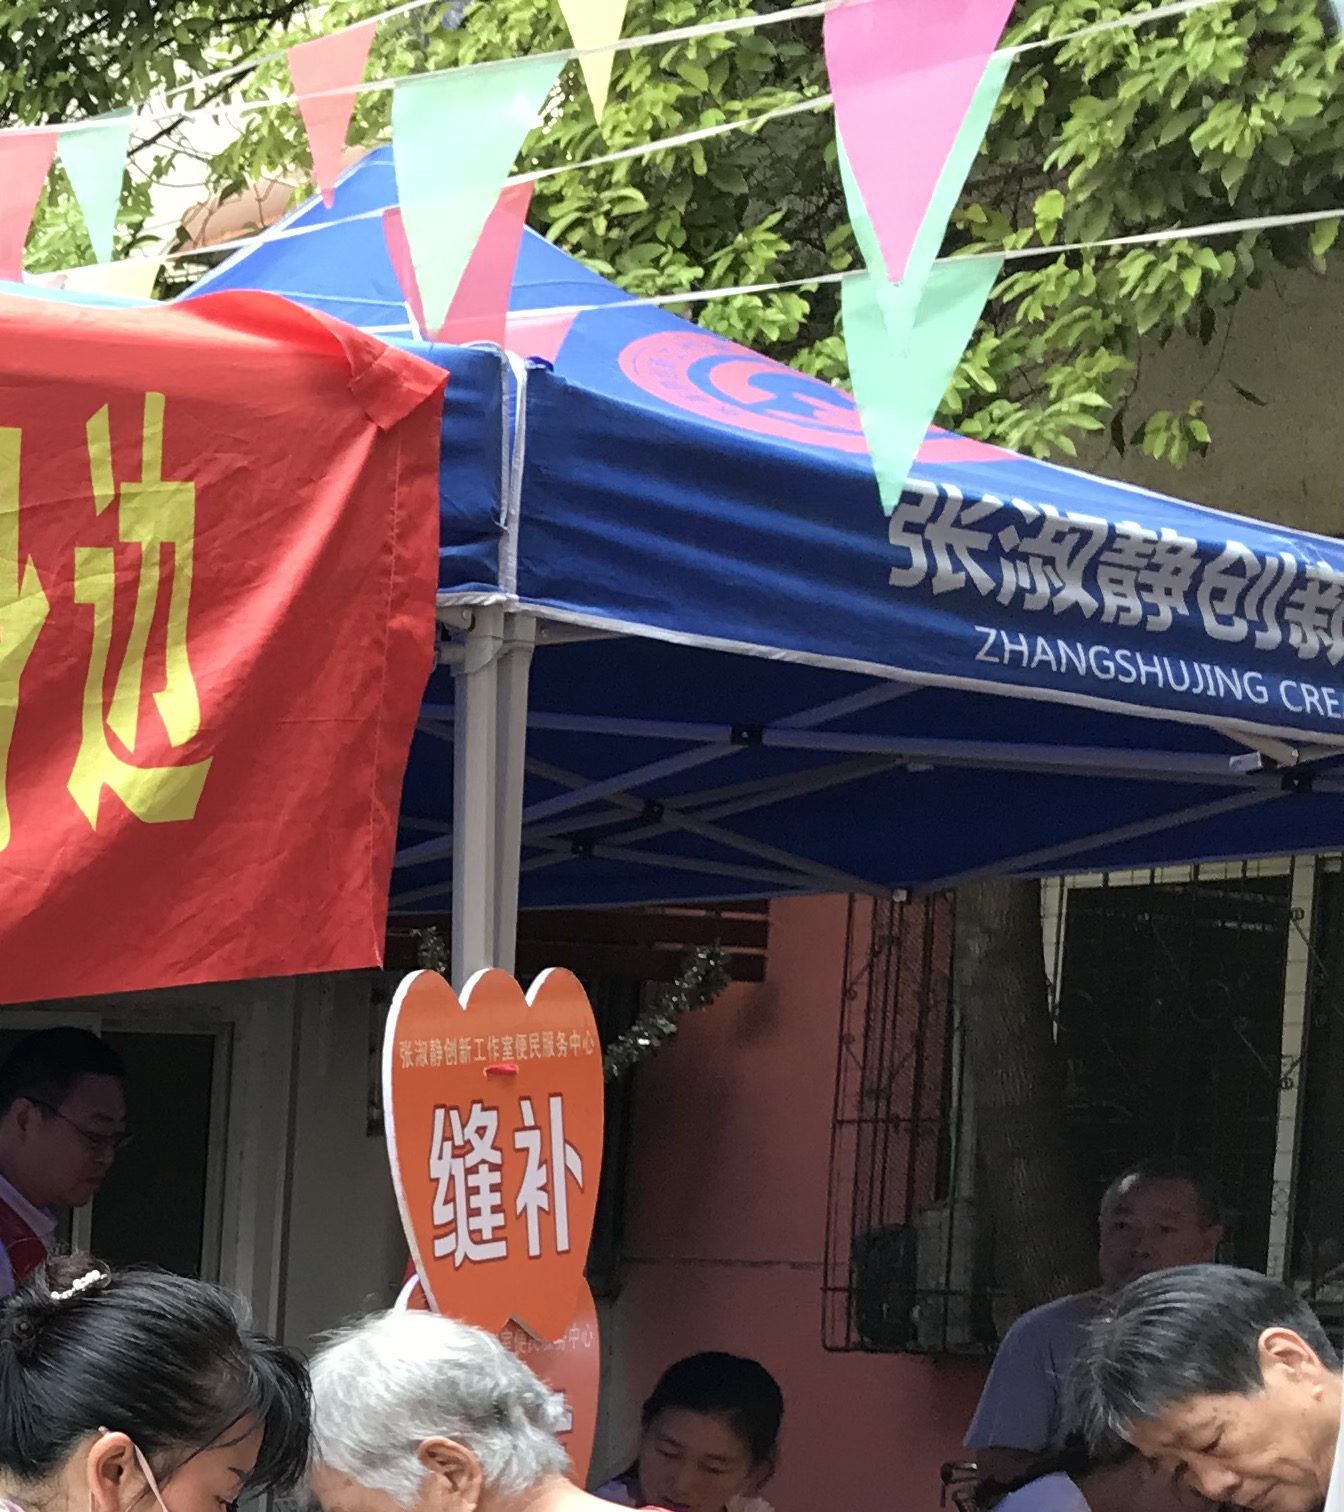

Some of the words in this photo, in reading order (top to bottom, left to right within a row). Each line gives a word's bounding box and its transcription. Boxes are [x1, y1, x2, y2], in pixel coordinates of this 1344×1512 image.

[973, 626, 1269, 705] ZHANGSHUJING
[1279, 679, 1344, 719] CRE
[398, 1029, 595, 1069] 张淑静创新工作室便民服务中心
[428, 1092, 584, 1269] 缝补
